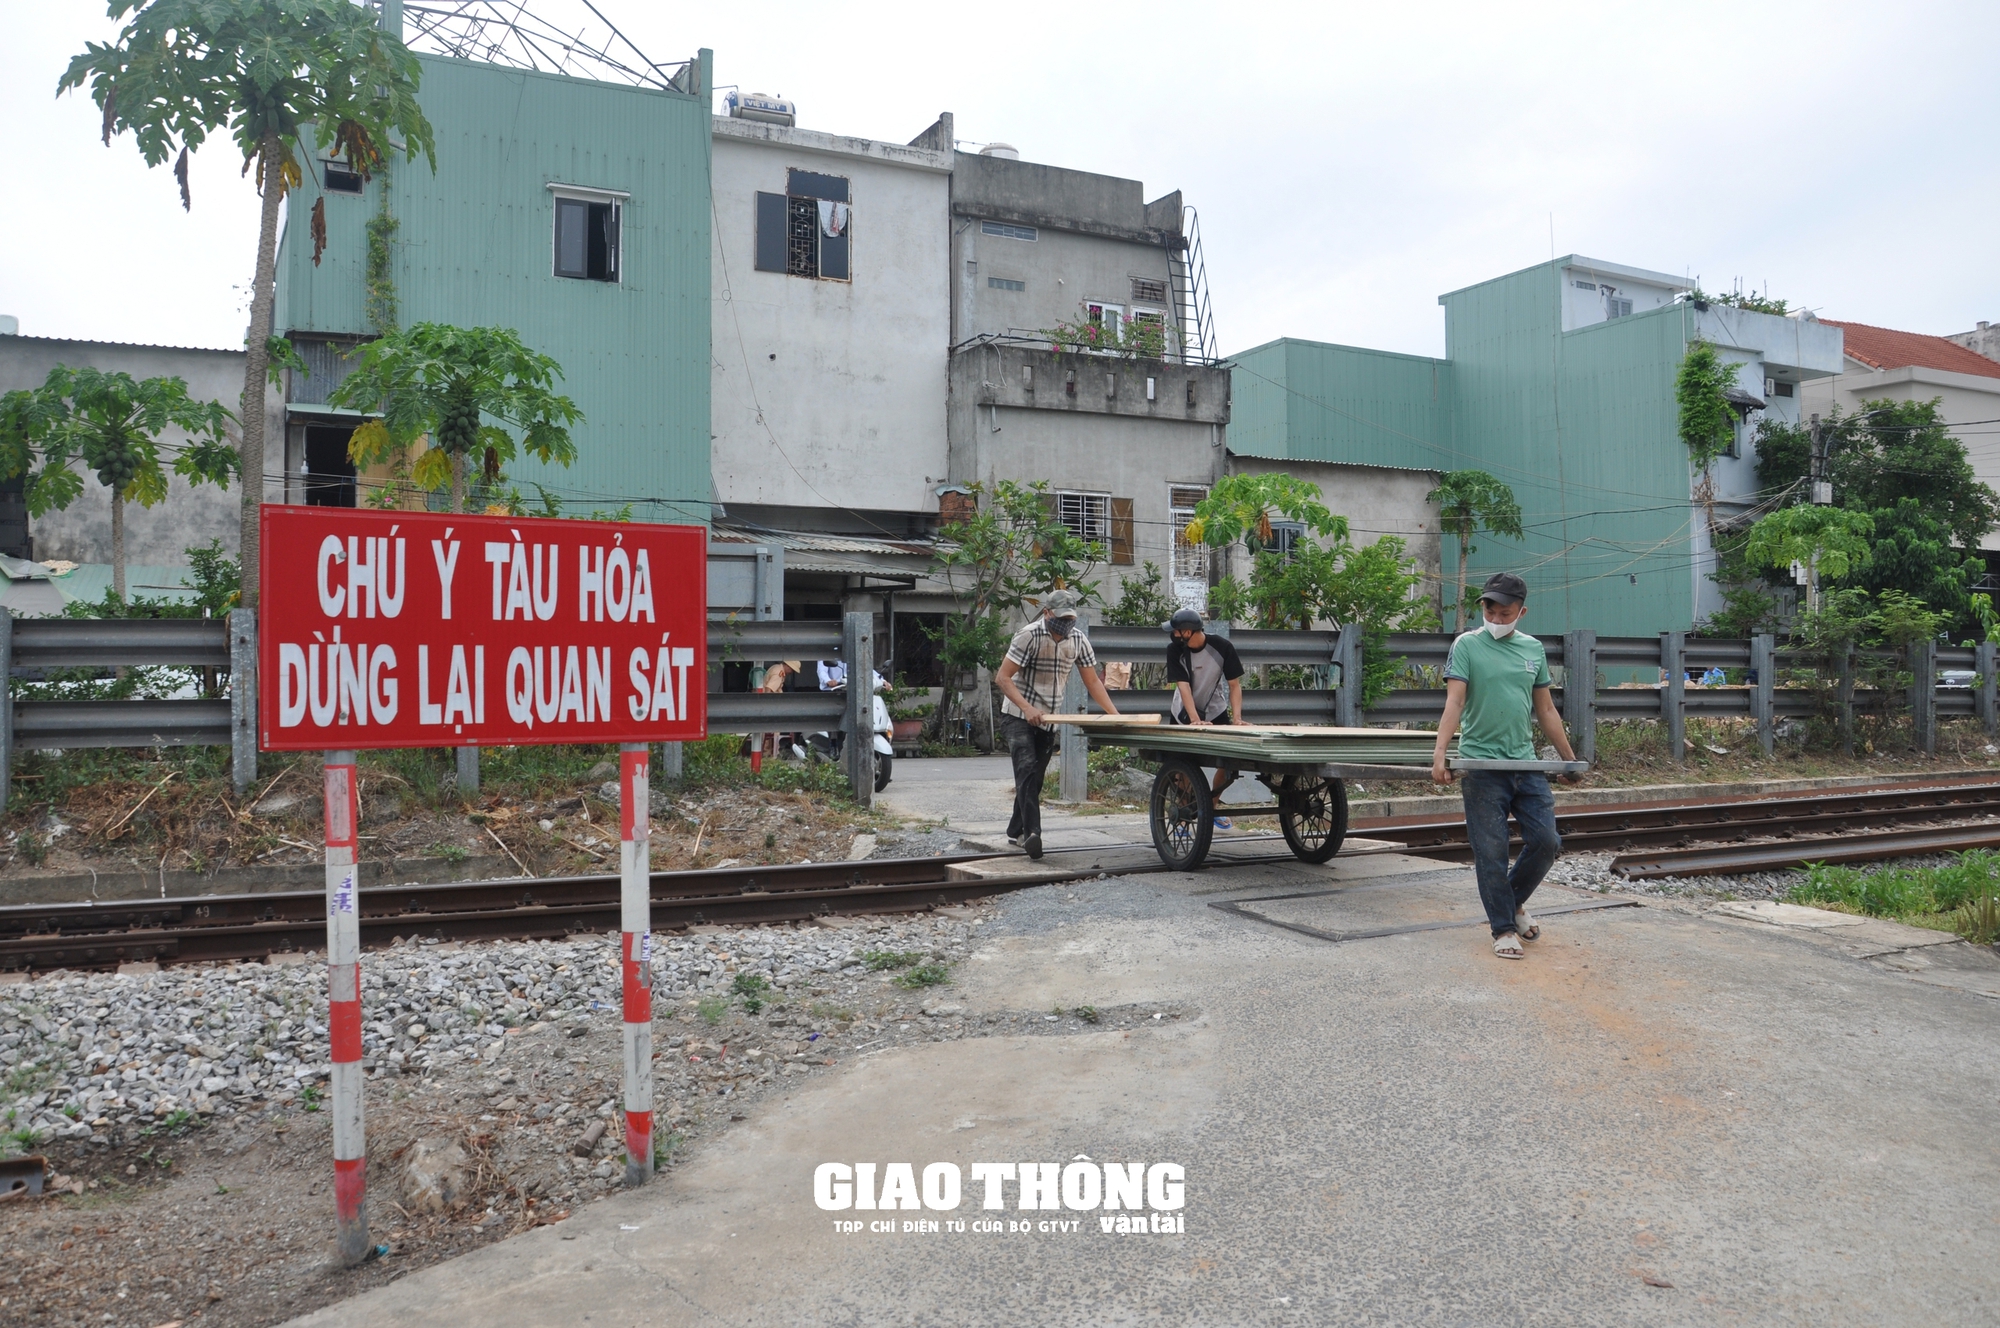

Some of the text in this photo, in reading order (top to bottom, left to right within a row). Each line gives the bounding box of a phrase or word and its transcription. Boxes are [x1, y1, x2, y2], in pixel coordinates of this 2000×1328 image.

[317, 525, 655, 624] CHÚ Ý TÀU HỎA
[279, 625, 694, 734] DỪNG LẠI QUAN SÁT
[195, 905, 210, 918] 49
